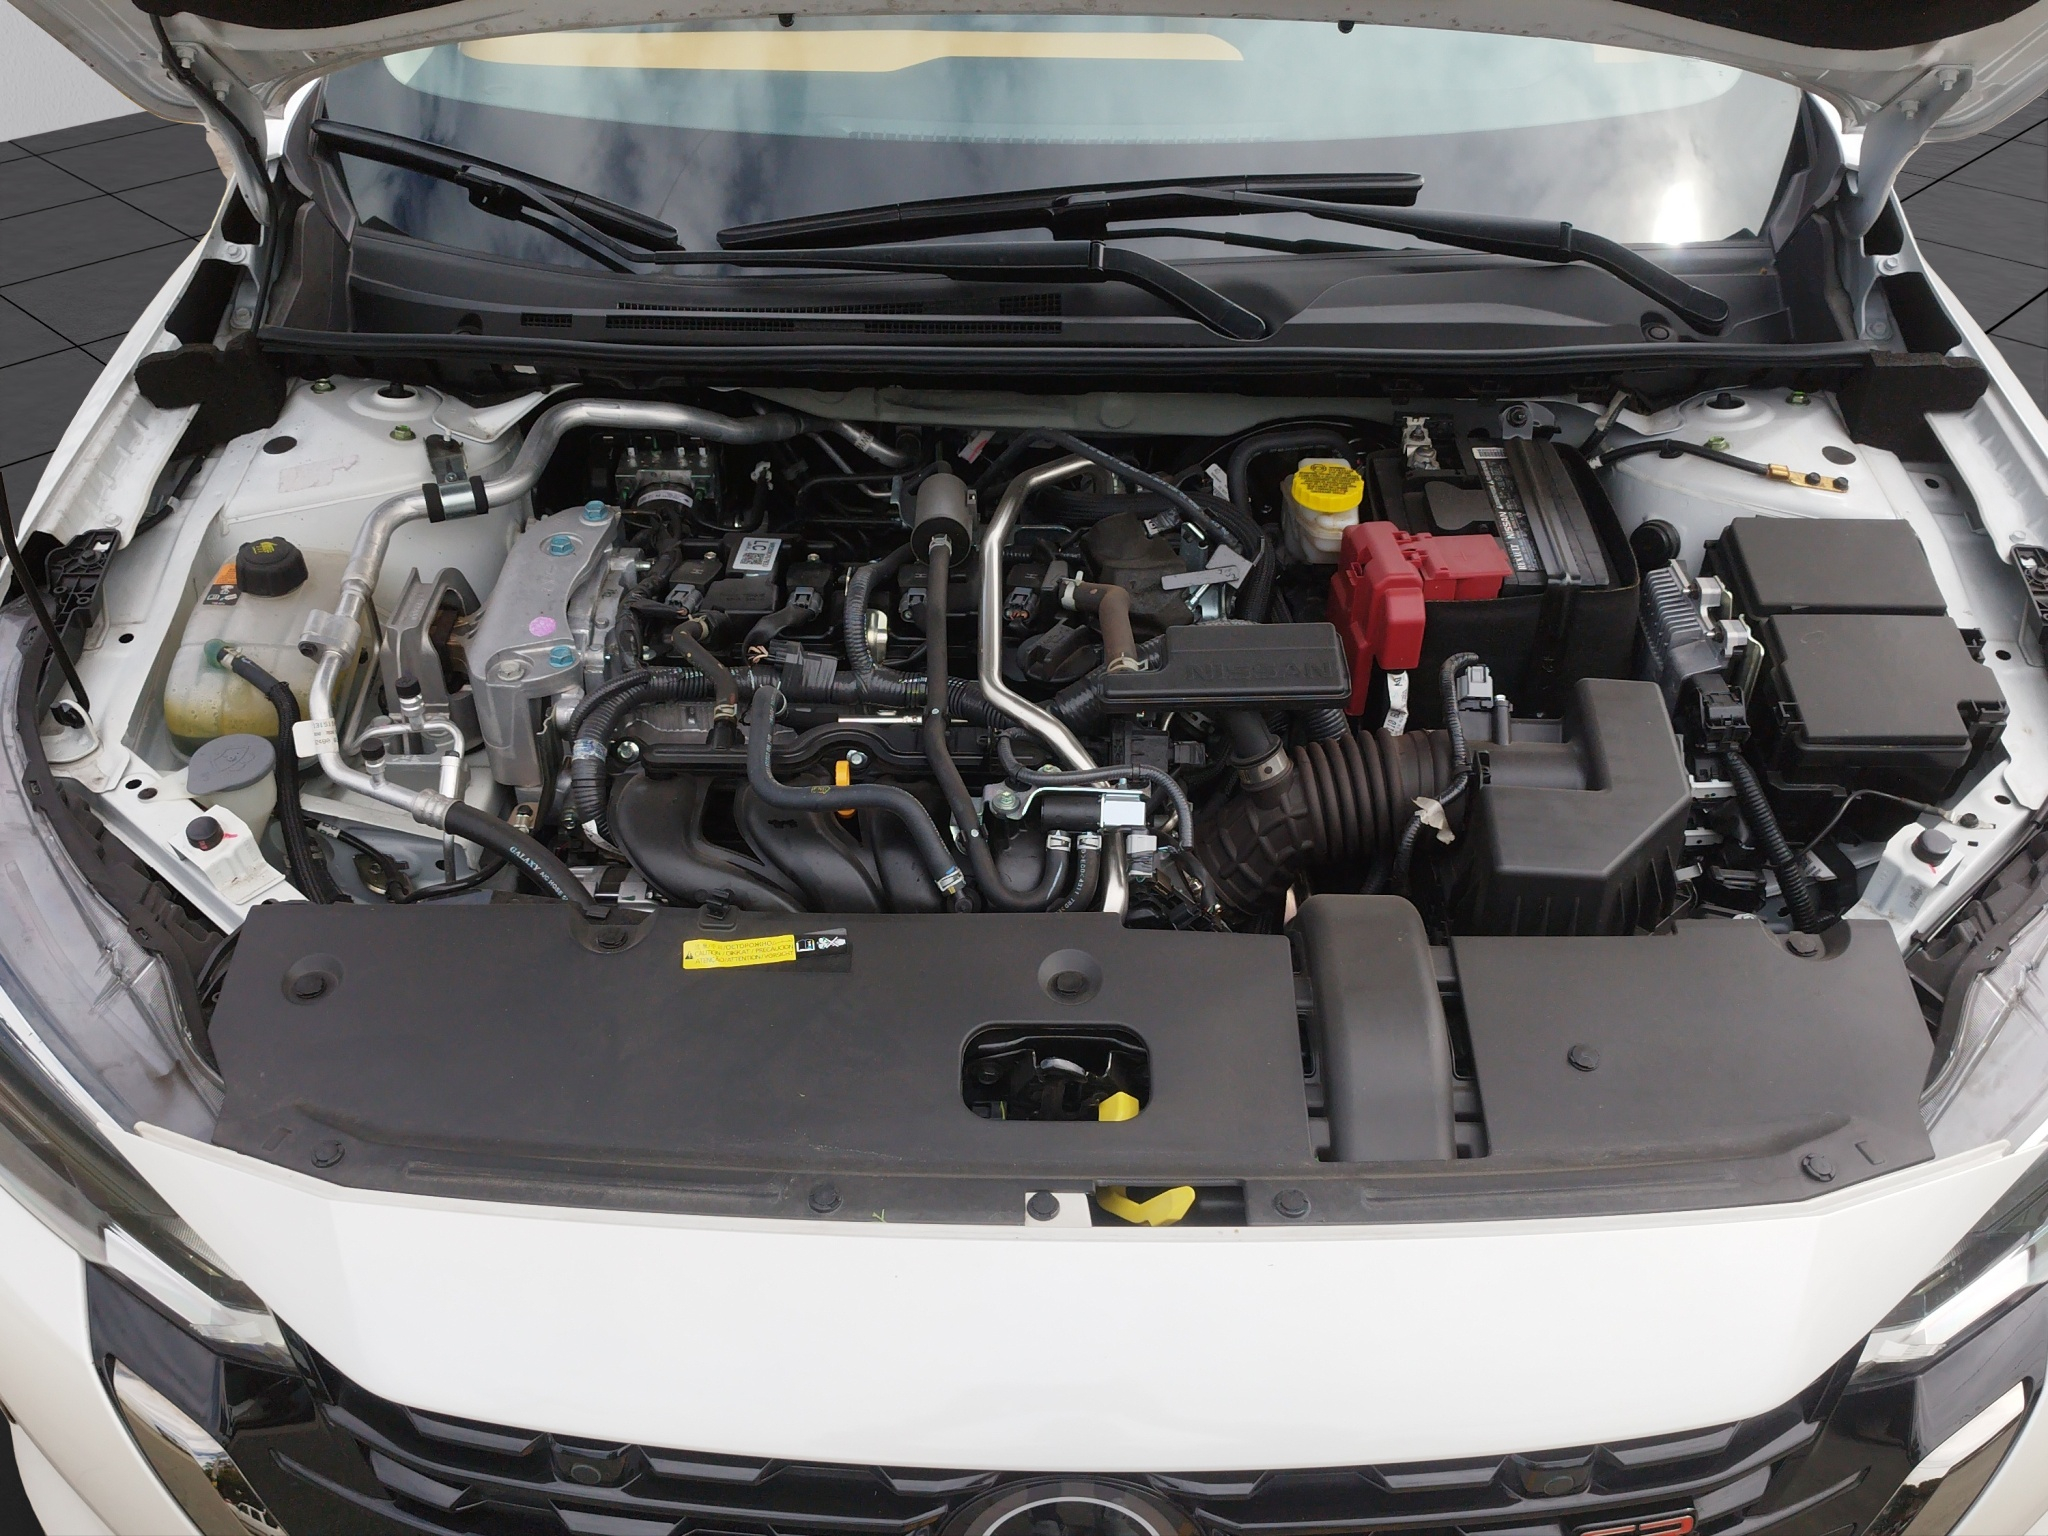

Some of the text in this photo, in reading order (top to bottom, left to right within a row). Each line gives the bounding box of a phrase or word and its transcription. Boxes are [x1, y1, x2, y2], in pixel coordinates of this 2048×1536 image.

[1499, 511, 1515, 539] NISSAN
[752, 540, 769, 551] LC
[1185, 660, 1334, 681] NISSAN
[509, 846, 541, 871] GALAXY
